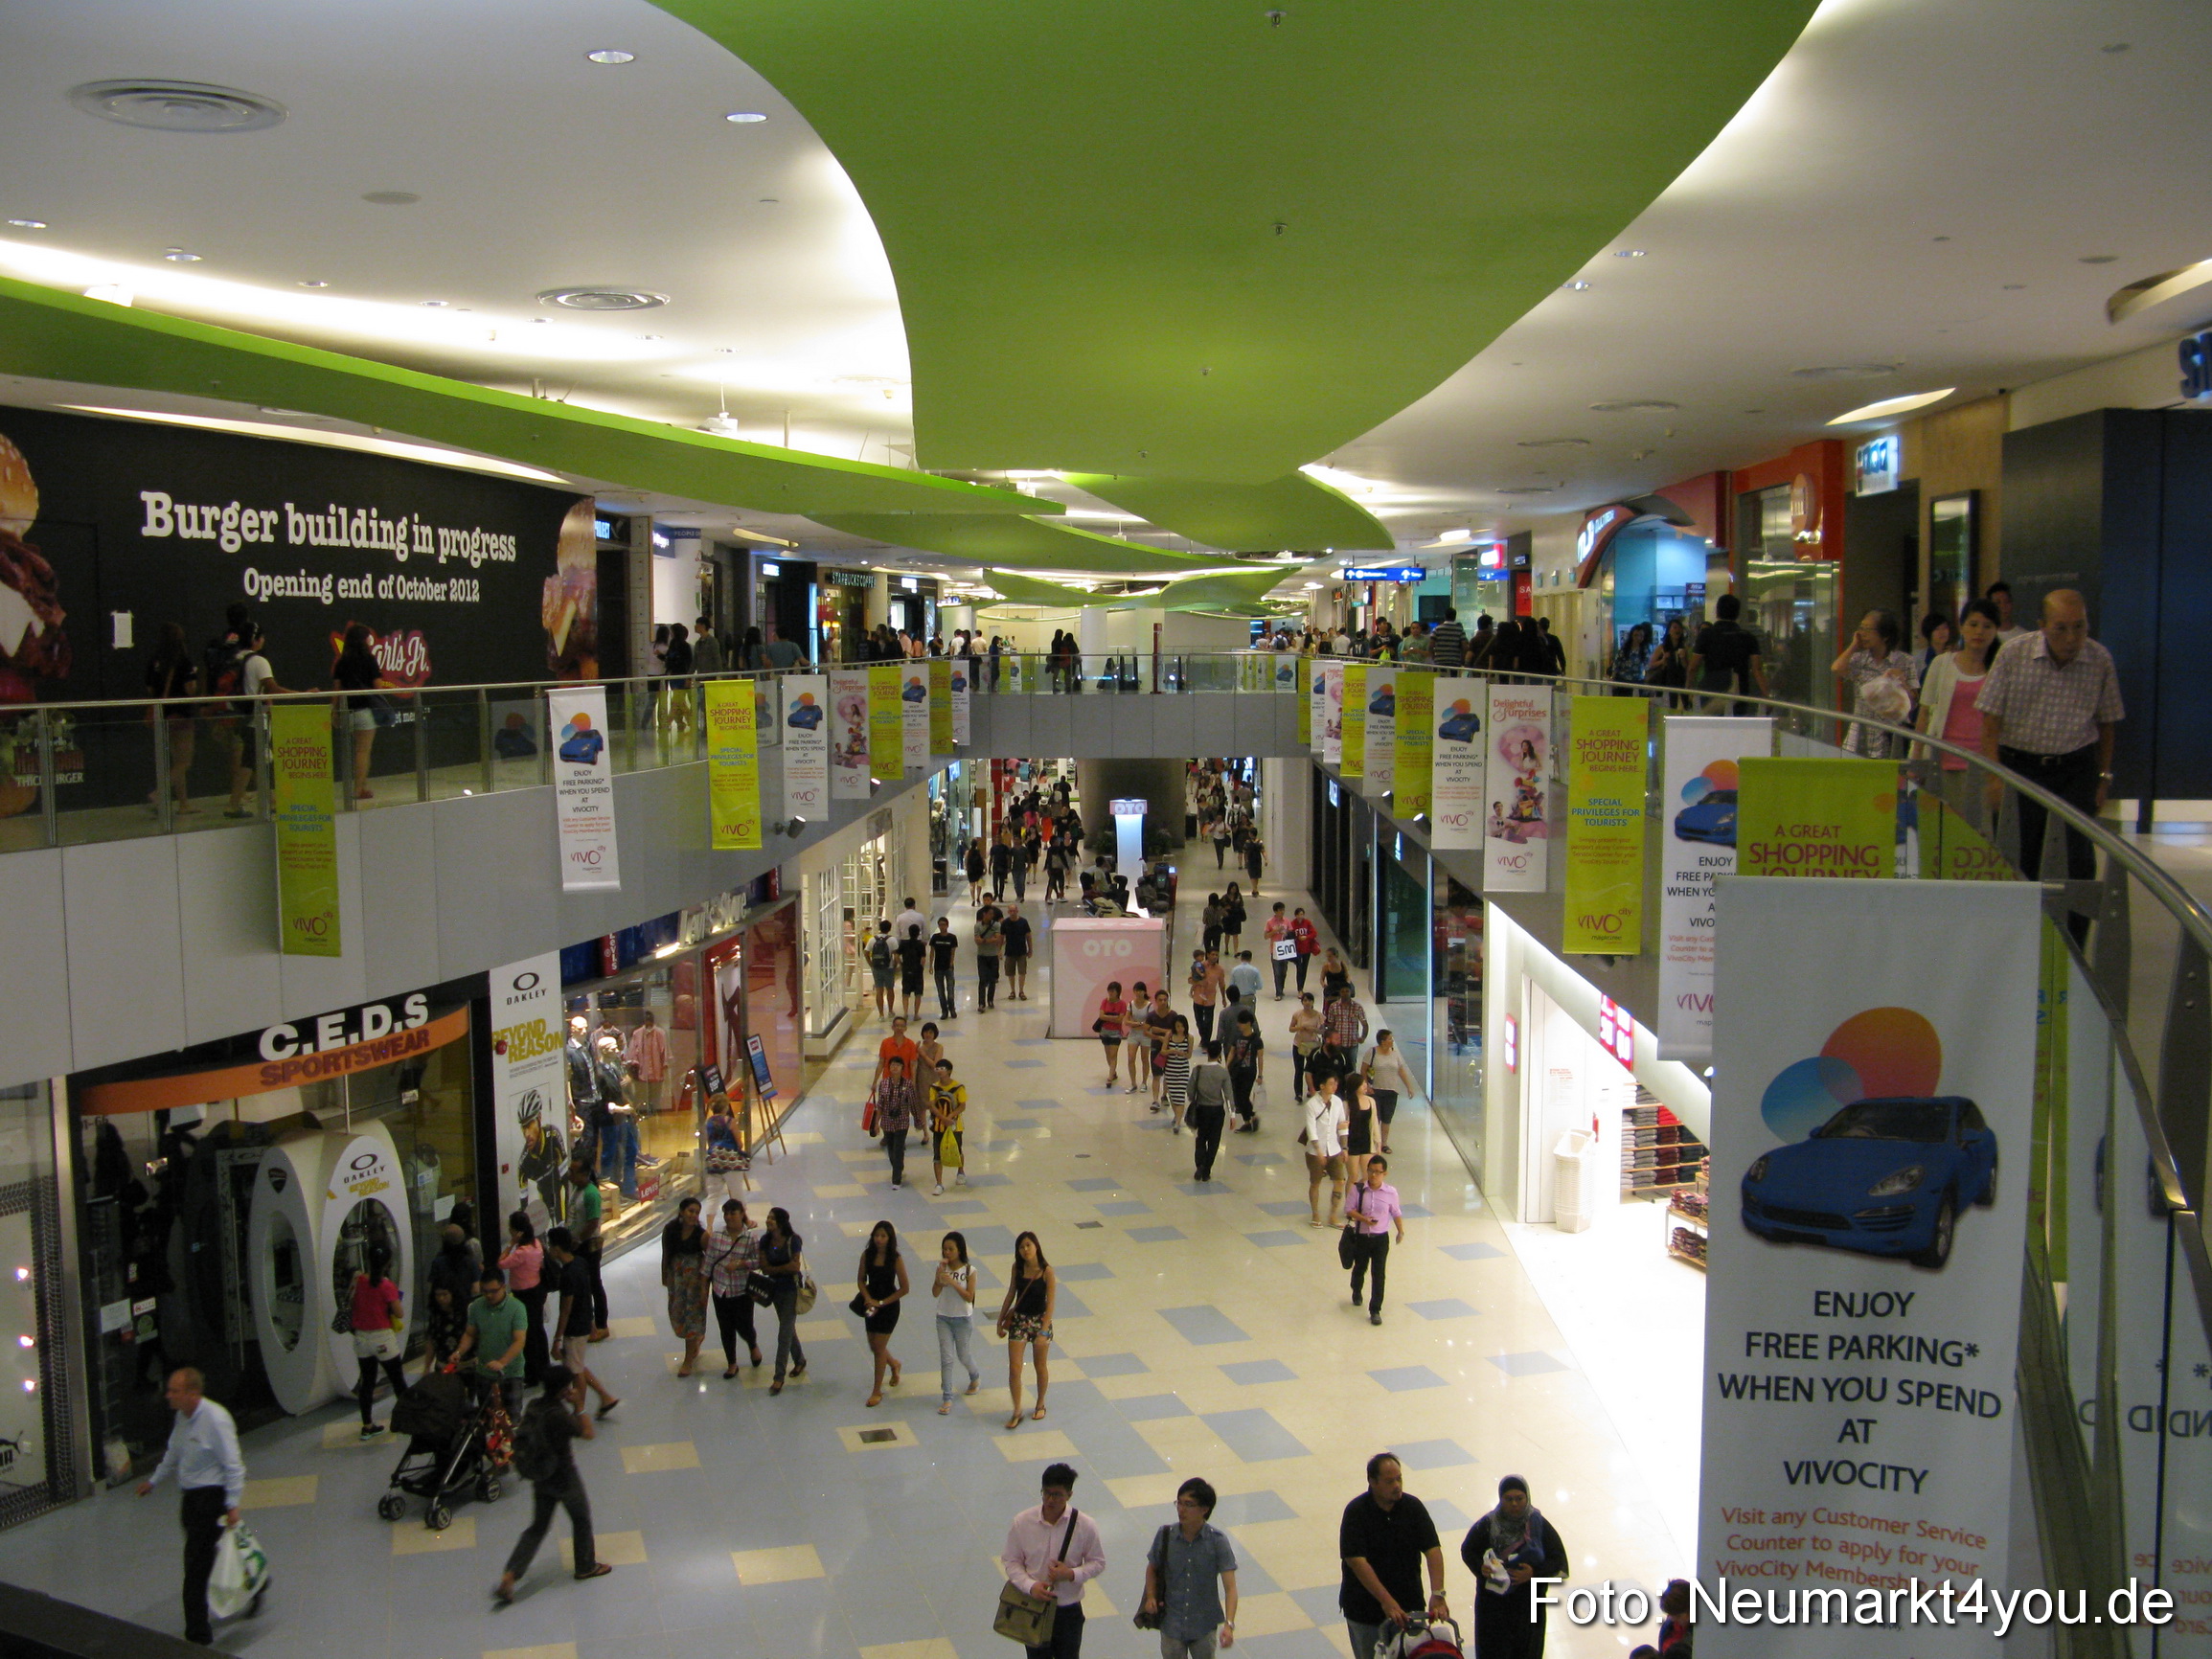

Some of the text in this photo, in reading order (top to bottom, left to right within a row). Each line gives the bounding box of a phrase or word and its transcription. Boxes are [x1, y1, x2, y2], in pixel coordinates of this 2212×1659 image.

[141, 490, 516, 568] Burger building in progress
[244, 567, 480, 604] Opening end of October 2012
[832, 572, 859, 586] STARBUCKS
[368, 634, 429, 676] arl's Jr.
[1494, 698, 1534, 711] Delightful
[710, 708, 751, 716] SHOPPING
[1493, 708, 1547, 722] Surprises
[714, 716, 752, 725] JOURNEY
[1576, 739, 1639, 751] SHOPPING
[277, 747, 327, 758] SHOPPING
[1581, 751, 1640, 764] JOURNEY
[282, 759, 328, 771] JOURNEY
[13, 772, 84, 786] THICRGER
[791, 791, 815, 802] VIVO
[1402, 795, 1426, 807] VIVO
[1114, 803, 1145, 814] OTO
[1572, 807, 1620, 816] PRIVILEGES
[1441, 814, 1468, 826] VIVO
[720, 823, 749, 836] VIVO
[1775, 825, 1841, 838] A GREAT
[571, 851, 601, 865] VIVO
[1497, 855, 1526, 869] VIVO
[1699, 856, 1732, 866] ENJOY
[1749, 843, 1880, 867] SHOPPING
[1676, 872, 1700, 881] FREE
[1668, 887, 1715, 897] WHEN YO
[293, 917, 328, 935] VIVO
[1578, 908, 1632, 933] VIVO city
[1690, 918, 1715, 927] VIVO
[1083, 940, 1132, 957] OTO
[1667, 955, 1696, 964] VivoCity
[506, 989, 547, 1006] OAKLEY
[1677, 993, 1714, 1013] VIV
[259, 993, 429, 1061] C.E.D.S
[492, 1018, 546, 1051] BEYOND
[508, 1031, 563, 1064] REASON
[260, 1029, 430, 1086] SPORTSWEAR
[344, 1165, 386, 1184] OAKLEY
[1814, 1290, 1915, 1318] ENJOY
[1745, 1331, 1819, 1360] FREE
[1718, 1373, 2001, 1419] WHEN YOU SPEND
[1837, 1419, 1878, 1443] AT
[1783, 1460, 1929, 1494] VIVOCITY
[1722, 1507, 1987, 1550] Visit any Customer Service
[1727, 1534, 1979, 1578] Counter to apply for your
[1716, 1559, 1799, 1580] VivoCity
[1806, 1560, 1927, 1598] Membershp
